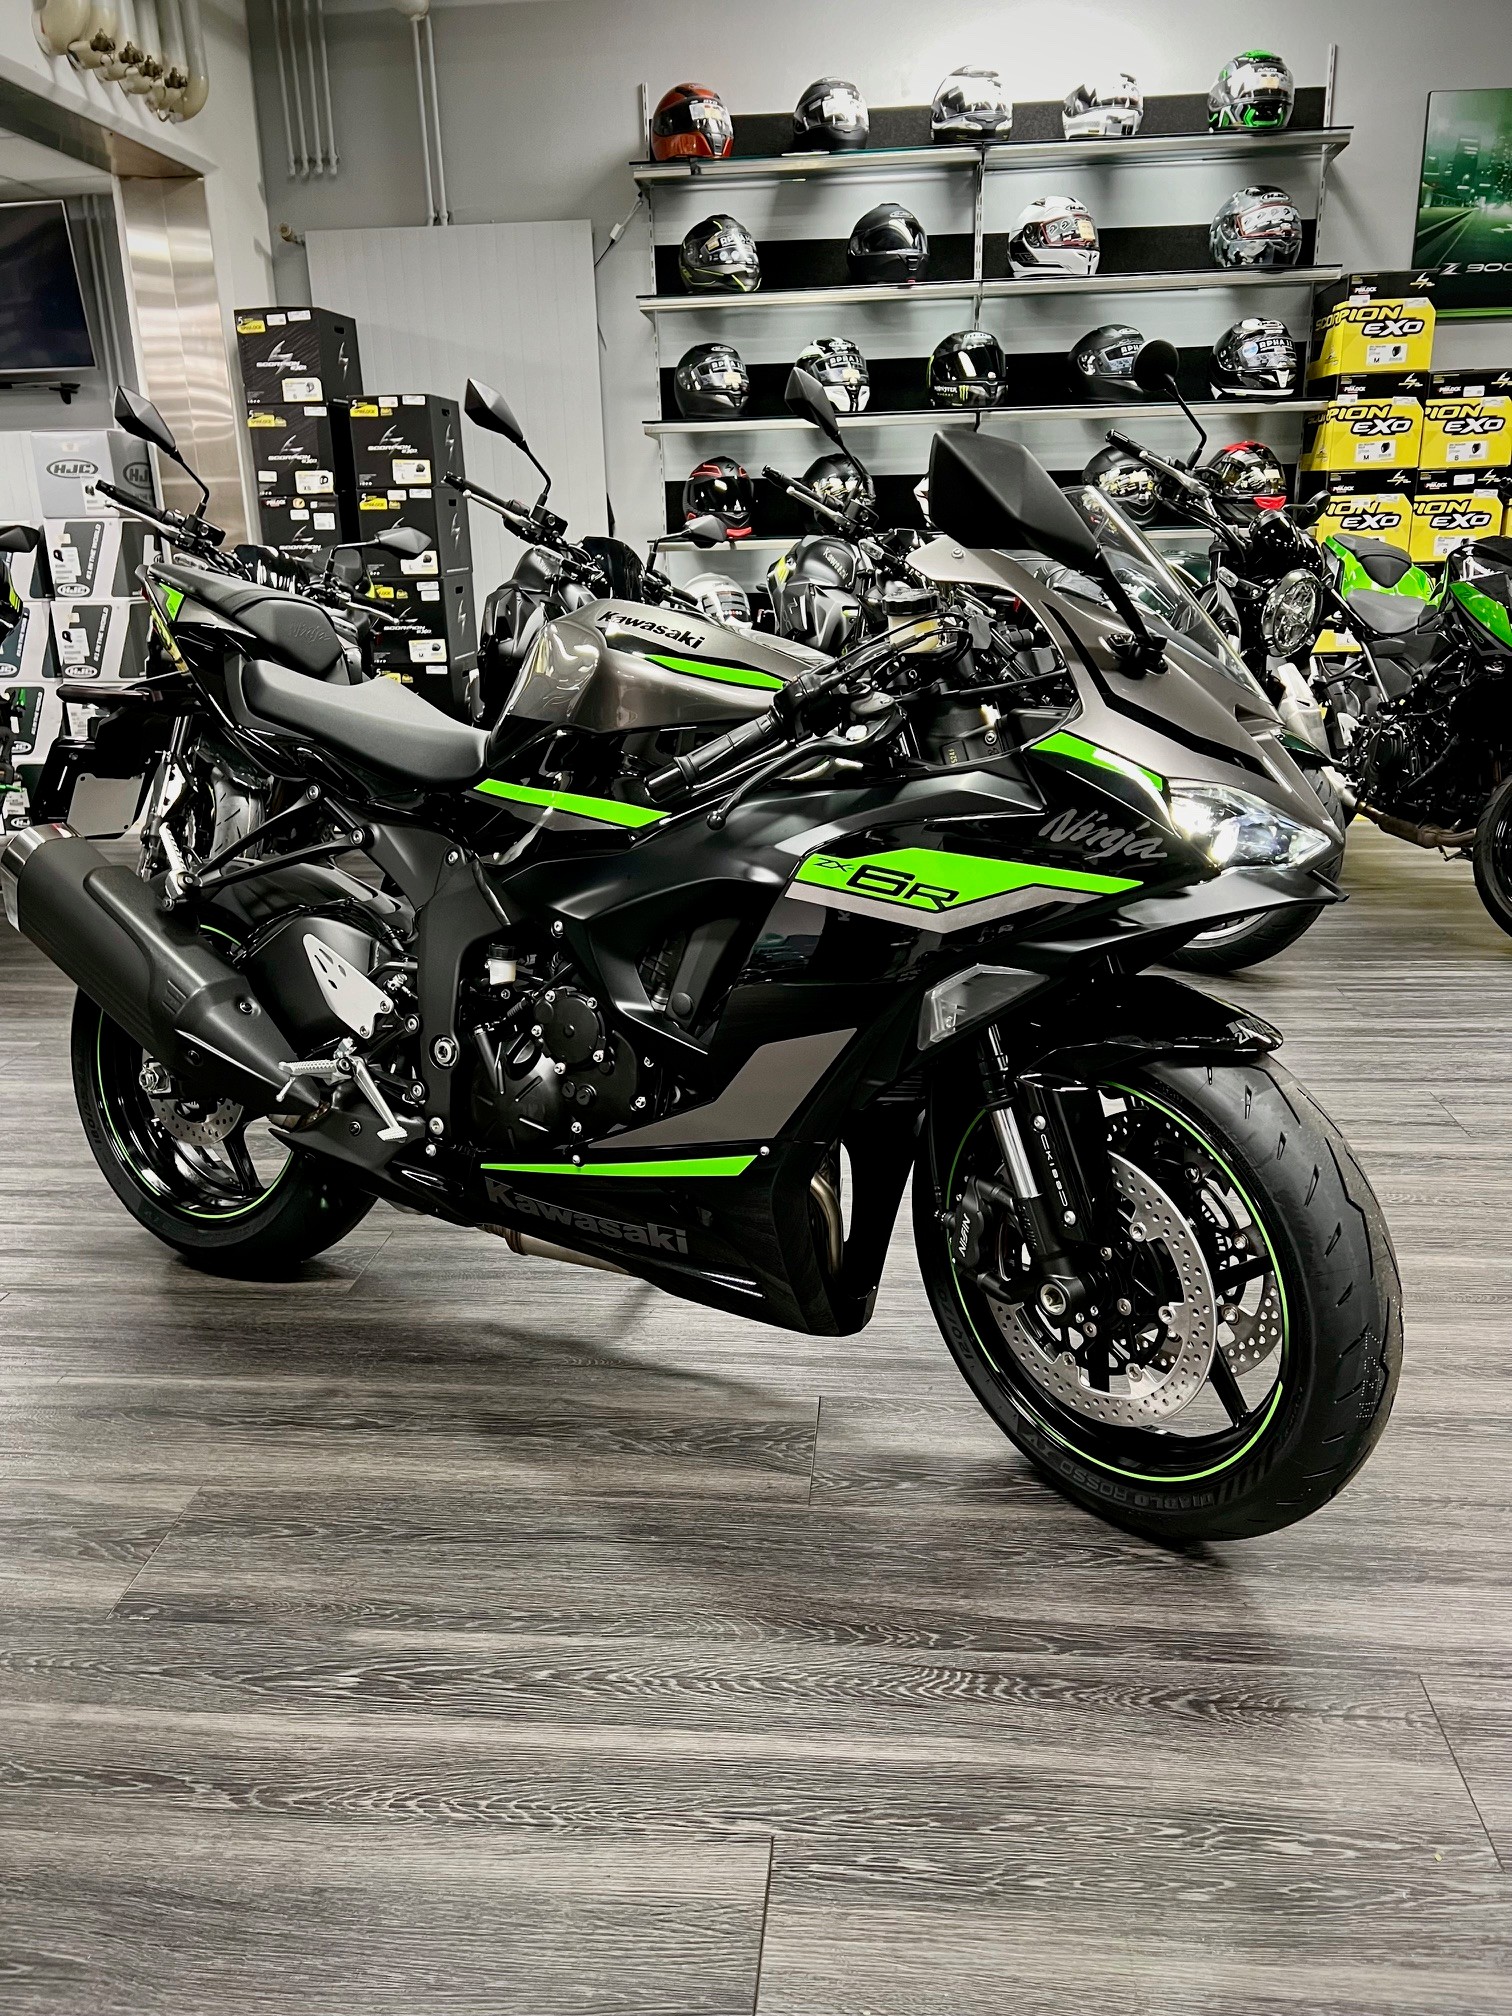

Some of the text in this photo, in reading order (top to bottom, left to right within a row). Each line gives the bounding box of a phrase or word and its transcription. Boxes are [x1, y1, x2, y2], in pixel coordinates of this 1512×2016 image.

[1440, 262, 1462, 275] Z
[1315, 305, 1402, 331] SCORPION
[1121, 345, 1141, 353] RPH
[53, 464, 92, 474] HJC
[598, 610, 706, 650] Kawasaki
[1038, 809, 1168, 860] Ninja
[484, 1176, 689, 1255] Kawasaki
[1058, 1460, 1128, 1500] ROSSO
[1134, 1492, 1213, 1509] DIABLO
